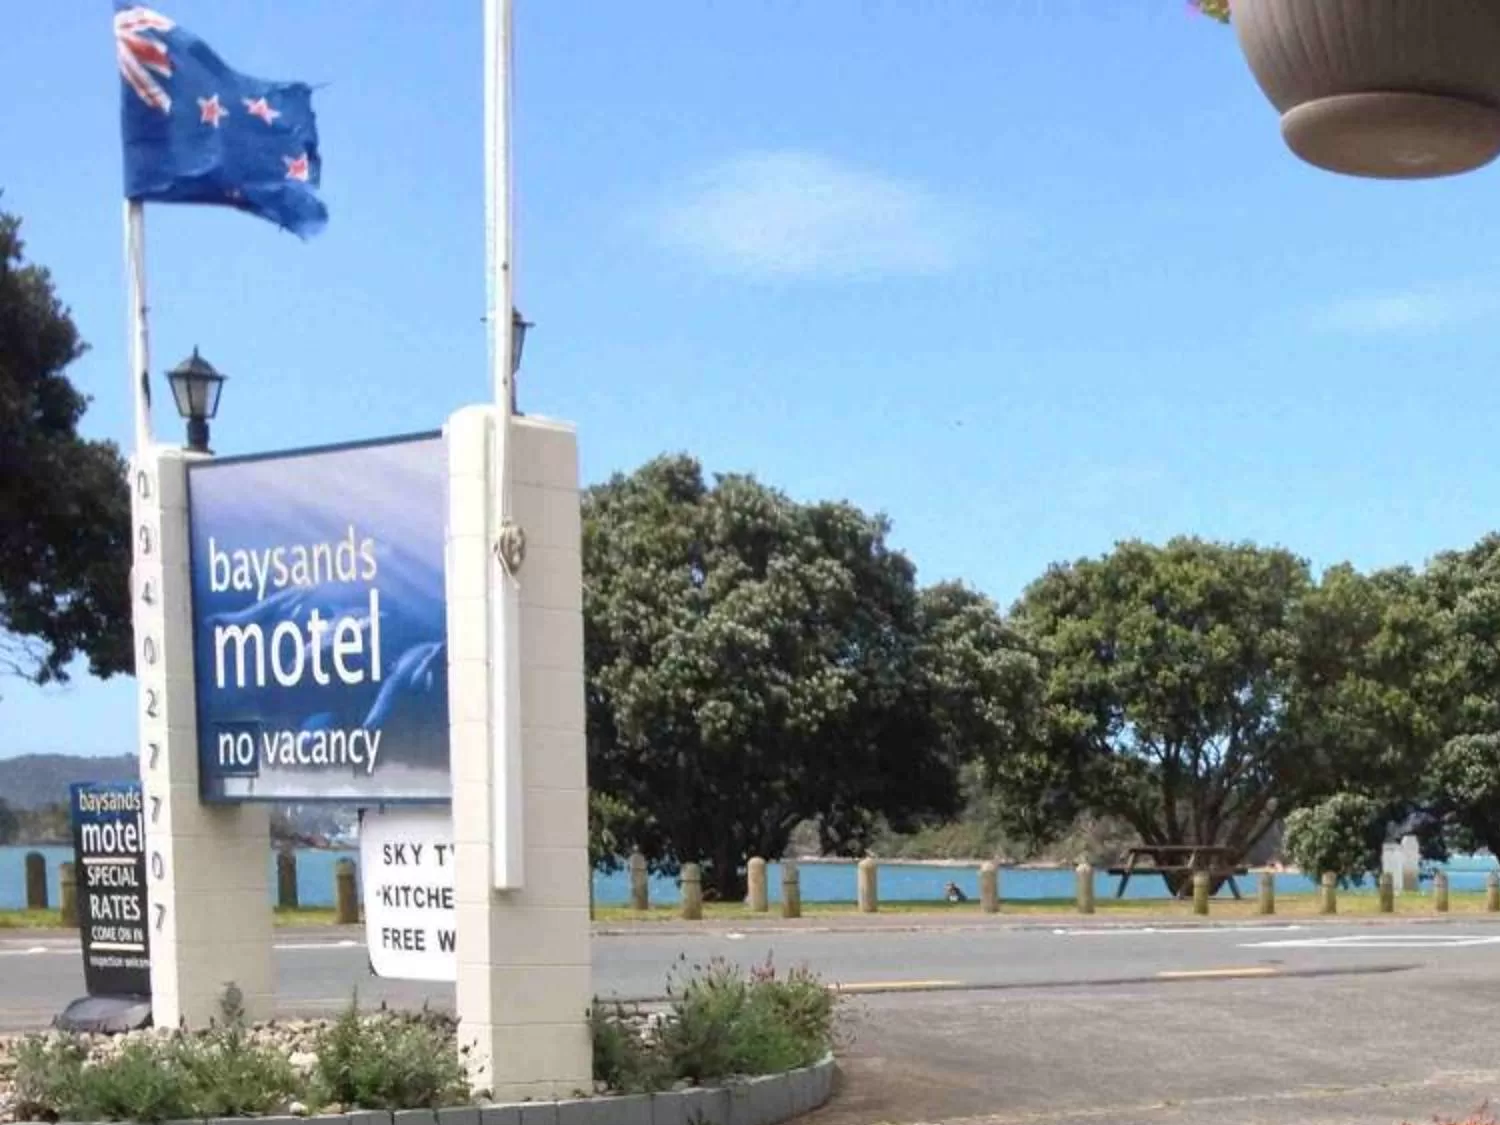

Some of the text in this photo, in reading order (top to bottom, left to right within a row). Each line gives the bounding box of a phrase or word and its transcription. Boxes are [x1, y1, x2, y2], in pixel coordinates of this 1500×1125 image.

[208, 524, 378, 601] baysands
[214, 587, 381, 688] motel
[218, 728, 382, 774] no vacancy
[78, 786, 142, 814] baysands
[81, 812, 144, 853] motel
[383, 843, 423, 866] SKY
[87, 865, 140, 887] SPECIAL
[90, 893, 141, 921] RATES
[91, 925, 117, 942] COME
[381, 927, 426, 951] FREE
